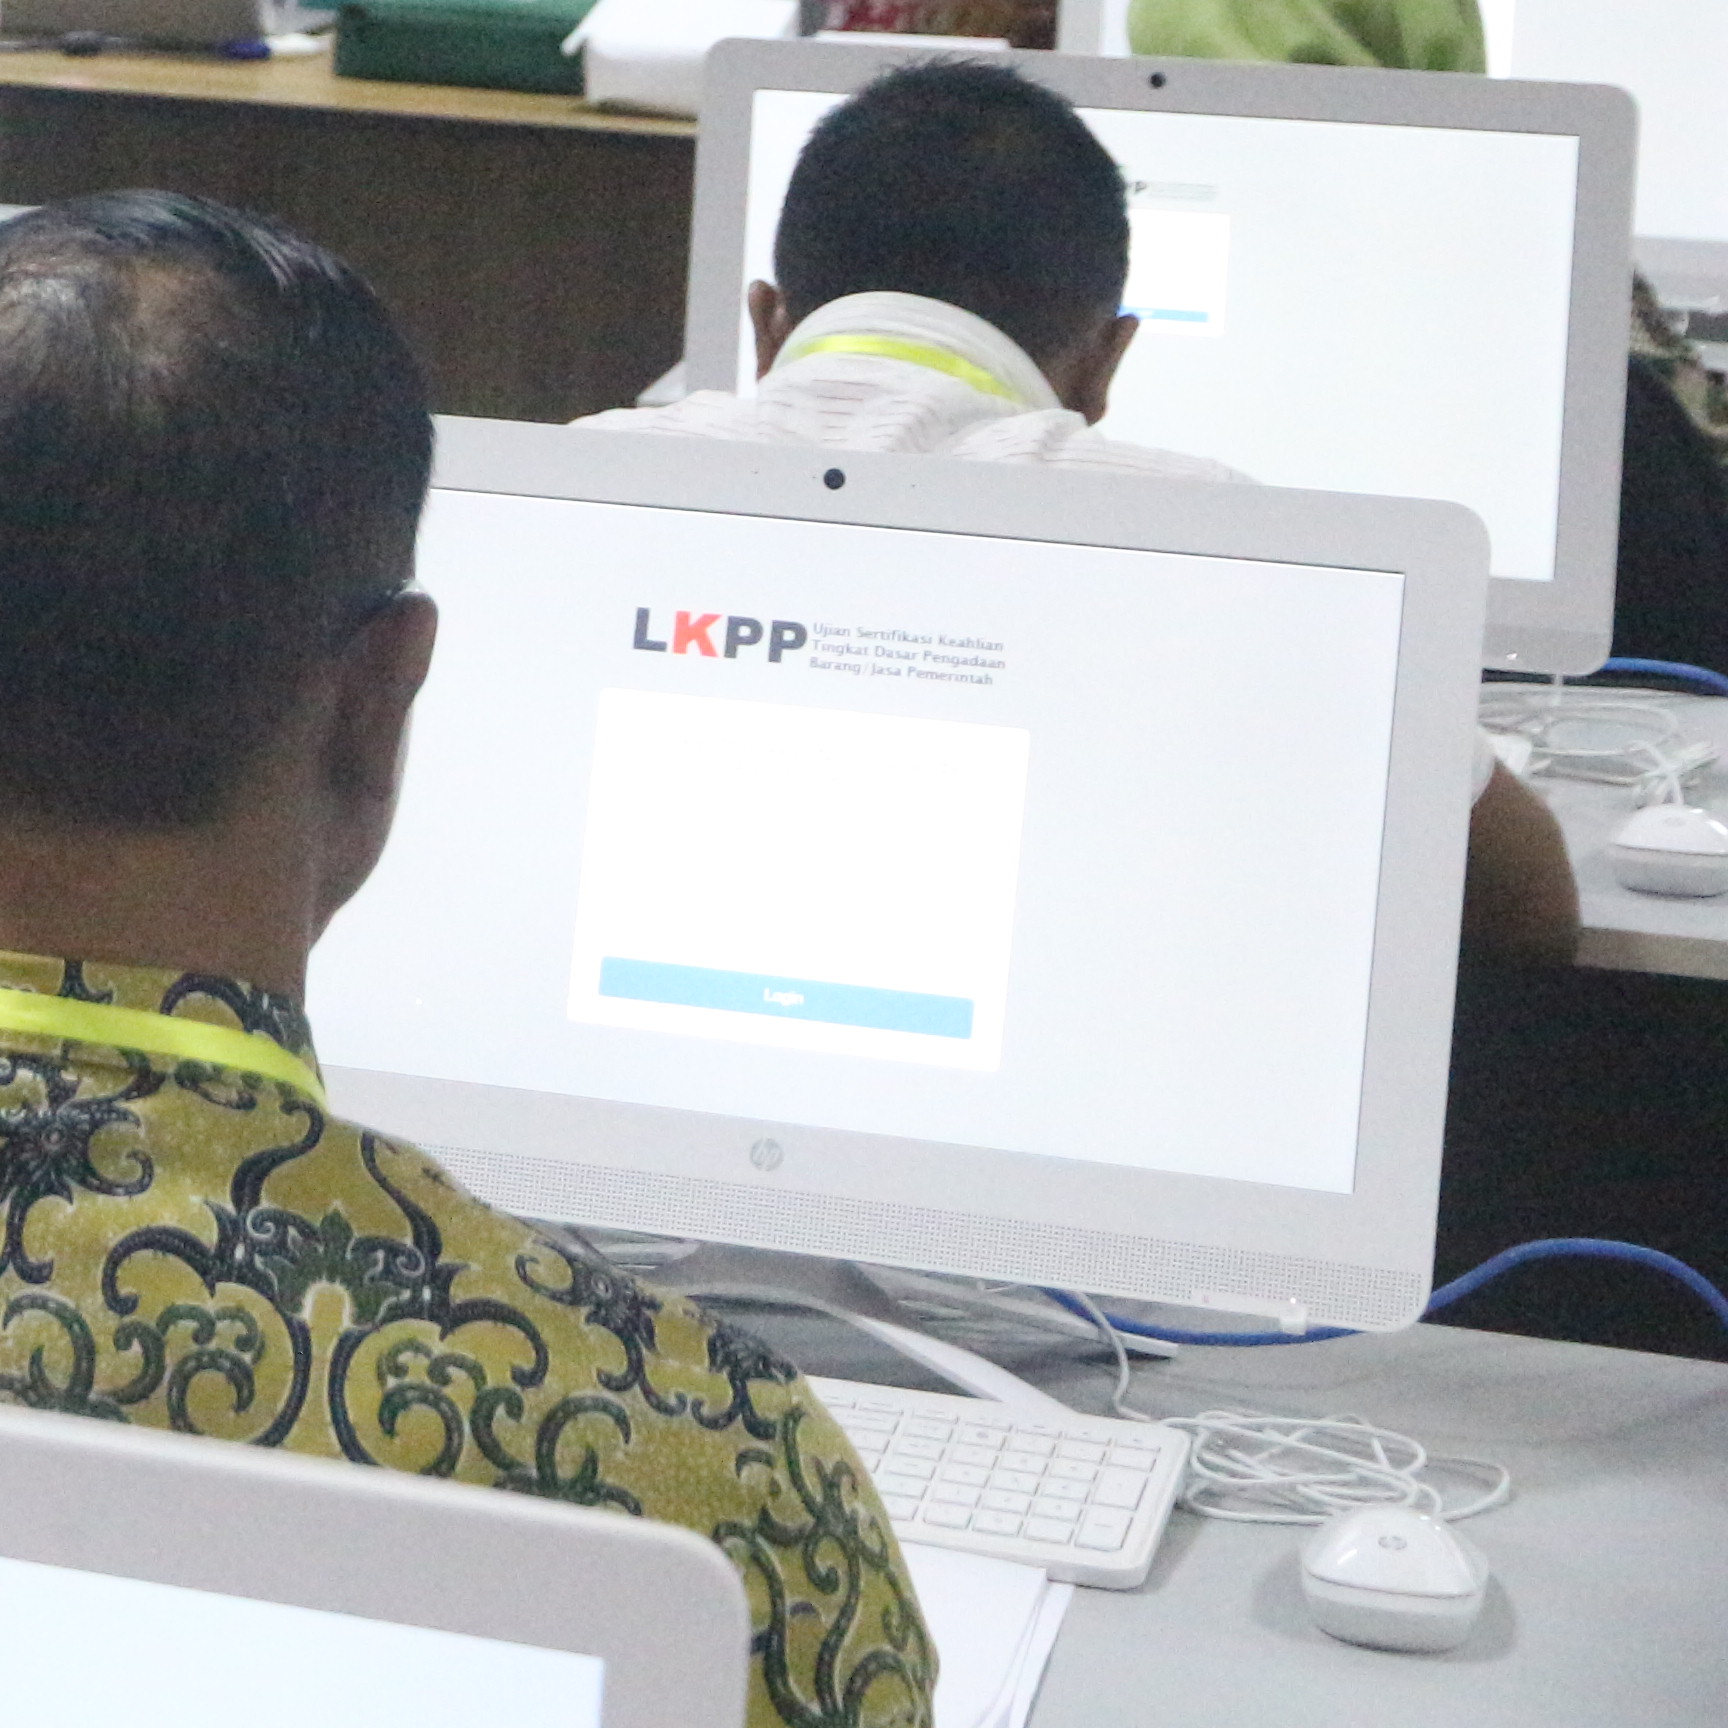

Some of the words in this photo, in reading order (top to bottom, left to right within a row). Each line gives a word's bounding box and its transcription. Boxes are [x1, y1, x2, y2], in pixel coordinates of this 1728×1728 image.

[632, 606, 808, 664] LKPP
[812, 622, 851, 638] Ujian
[856, 626, 933, 645] Sertifikasi
[937, 634, 1004, 652] Keahlian
[812, 639, 869, 657] Tingkat
[874, 645, 918, 661] Dasar
[922, 650, 1007, 670] Pengadaan
[906, 666, 994, 685] Pemerintah
